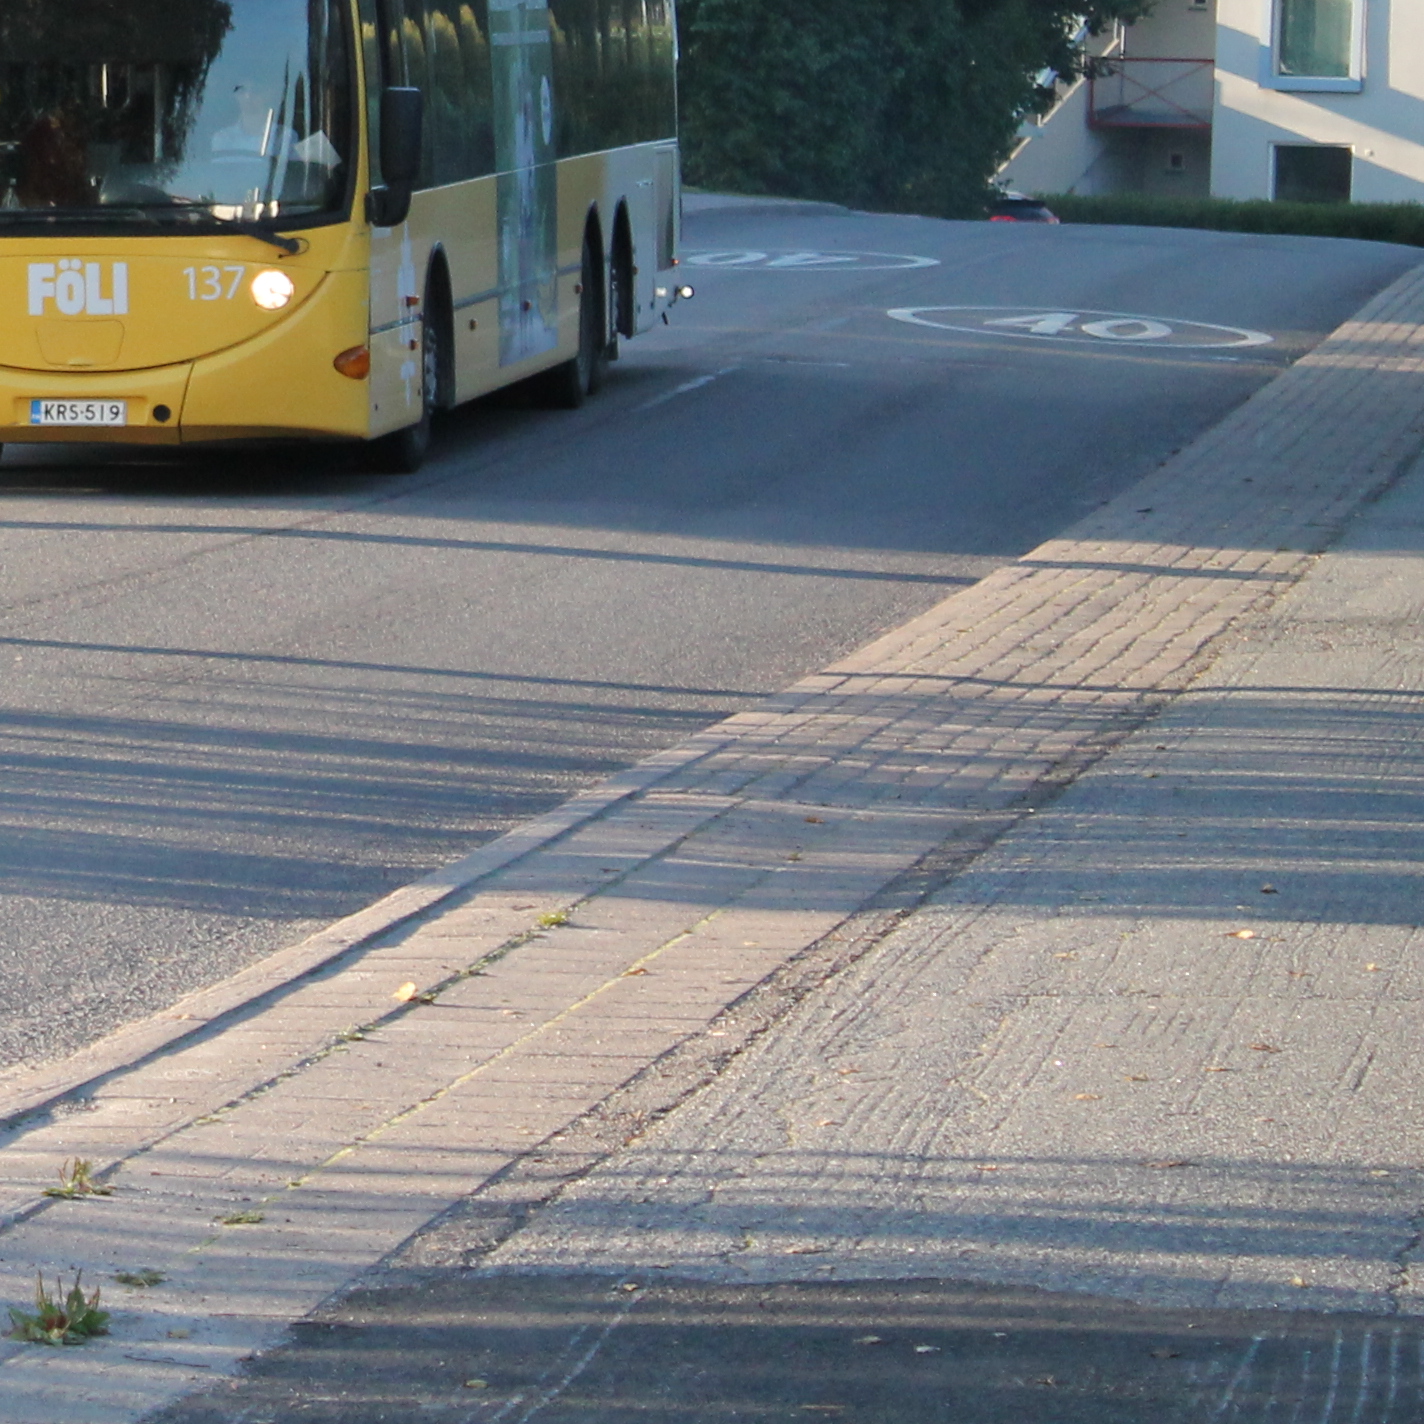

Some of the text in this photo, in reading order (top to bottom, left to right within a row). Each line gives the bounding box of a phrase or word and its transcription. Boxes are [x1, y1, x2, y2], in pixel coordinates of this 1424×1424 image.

[27, 258, 130, 316] FÖLI
[182, 265, 246, 301] 137
[983, 312, 1172, 340] 40
[43, 403, 121, 422] KRS-519
